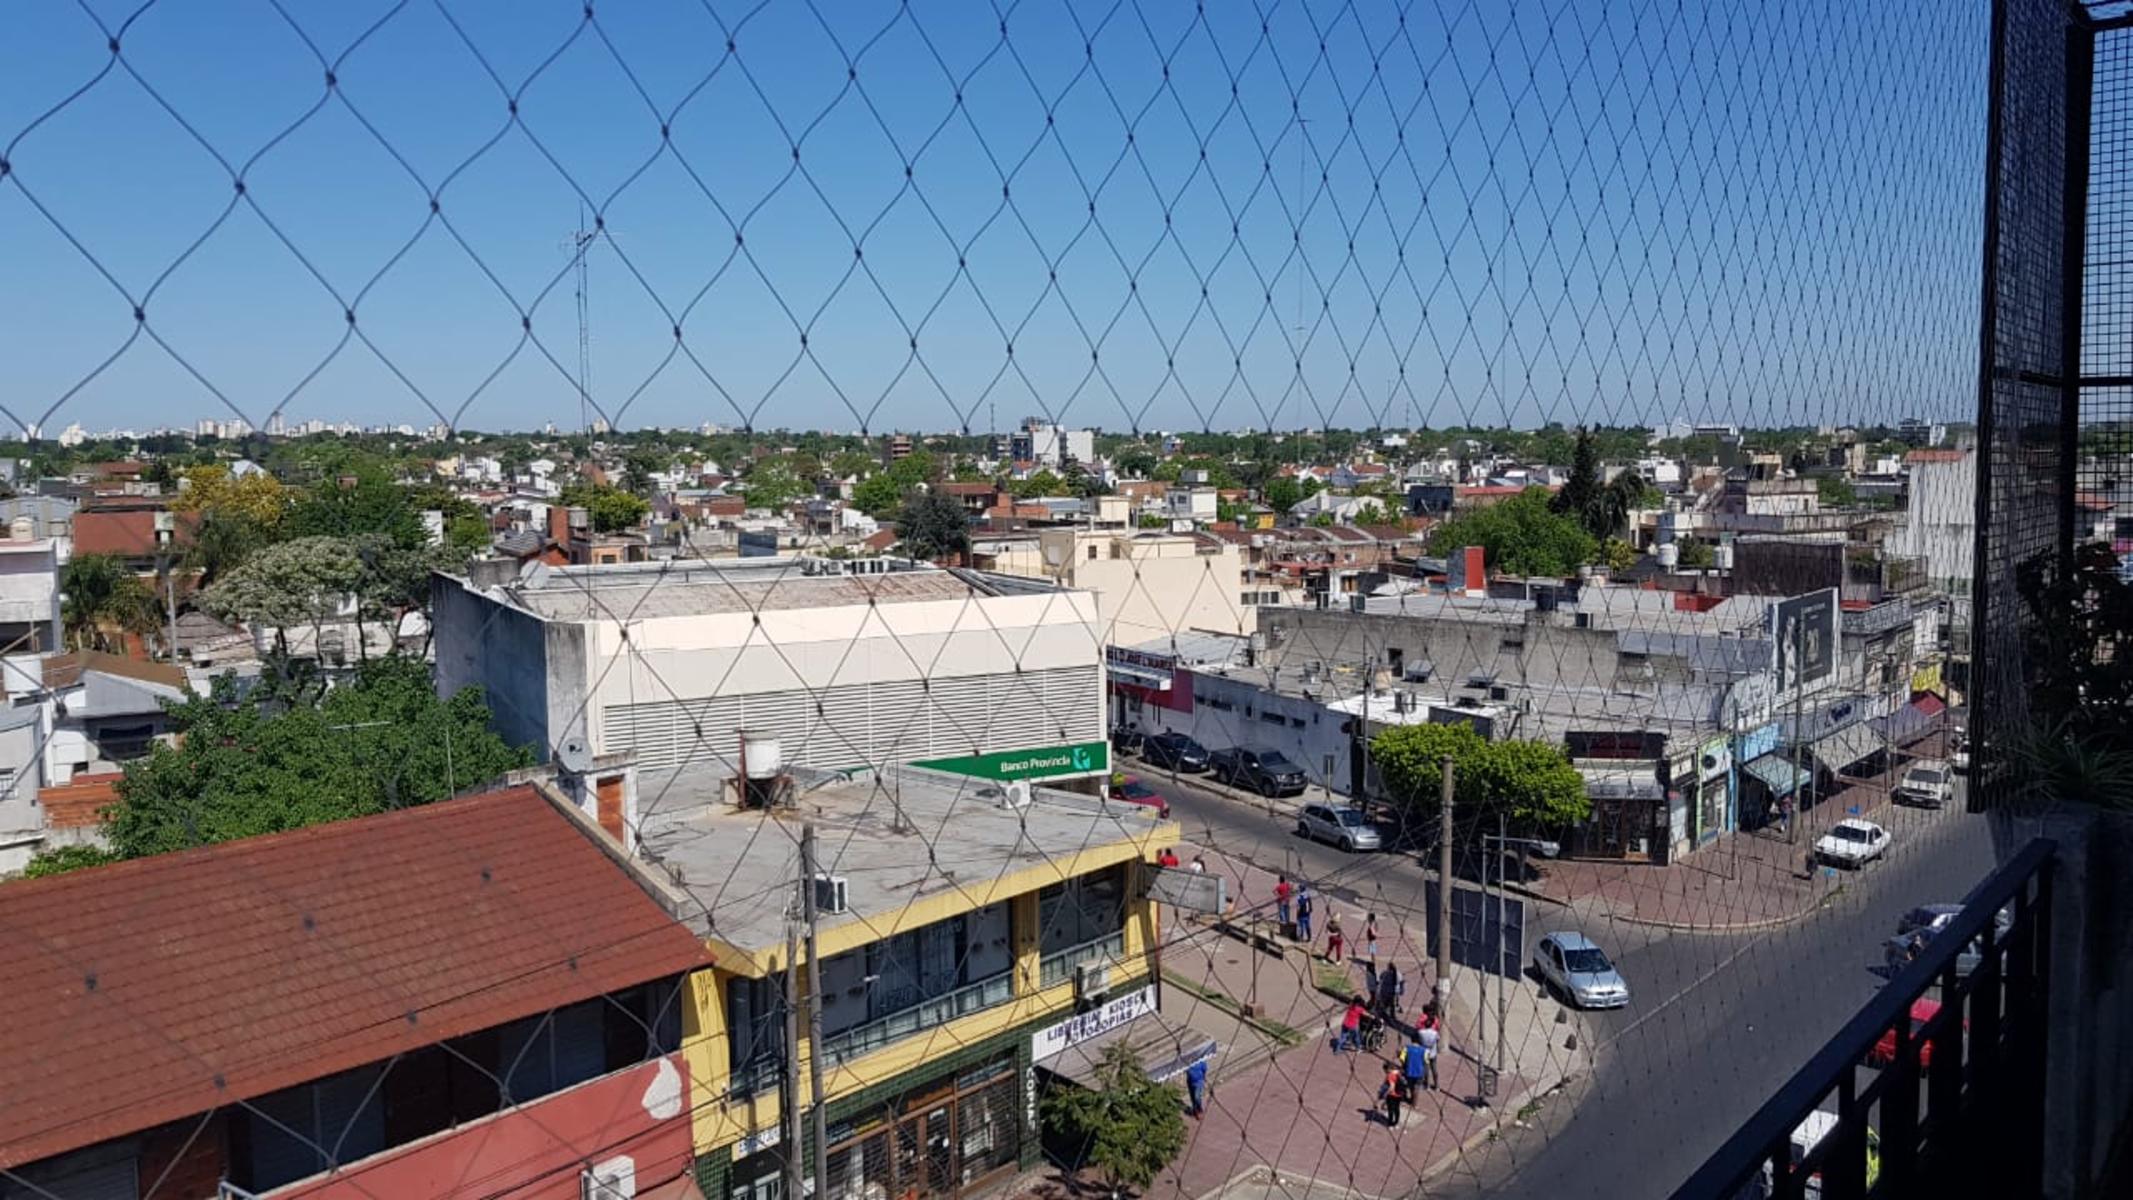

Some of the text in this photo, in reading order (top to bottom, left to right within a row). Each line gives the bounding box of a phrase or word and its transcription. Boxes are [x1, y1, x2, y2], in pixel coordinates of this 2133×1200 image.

[1001, 756, 1071, 772] Banco Provincia
[1109, 991, 1147, 1015] KIOSC
[1066, 1009, 1133, 1043] OTOCOPIAS
